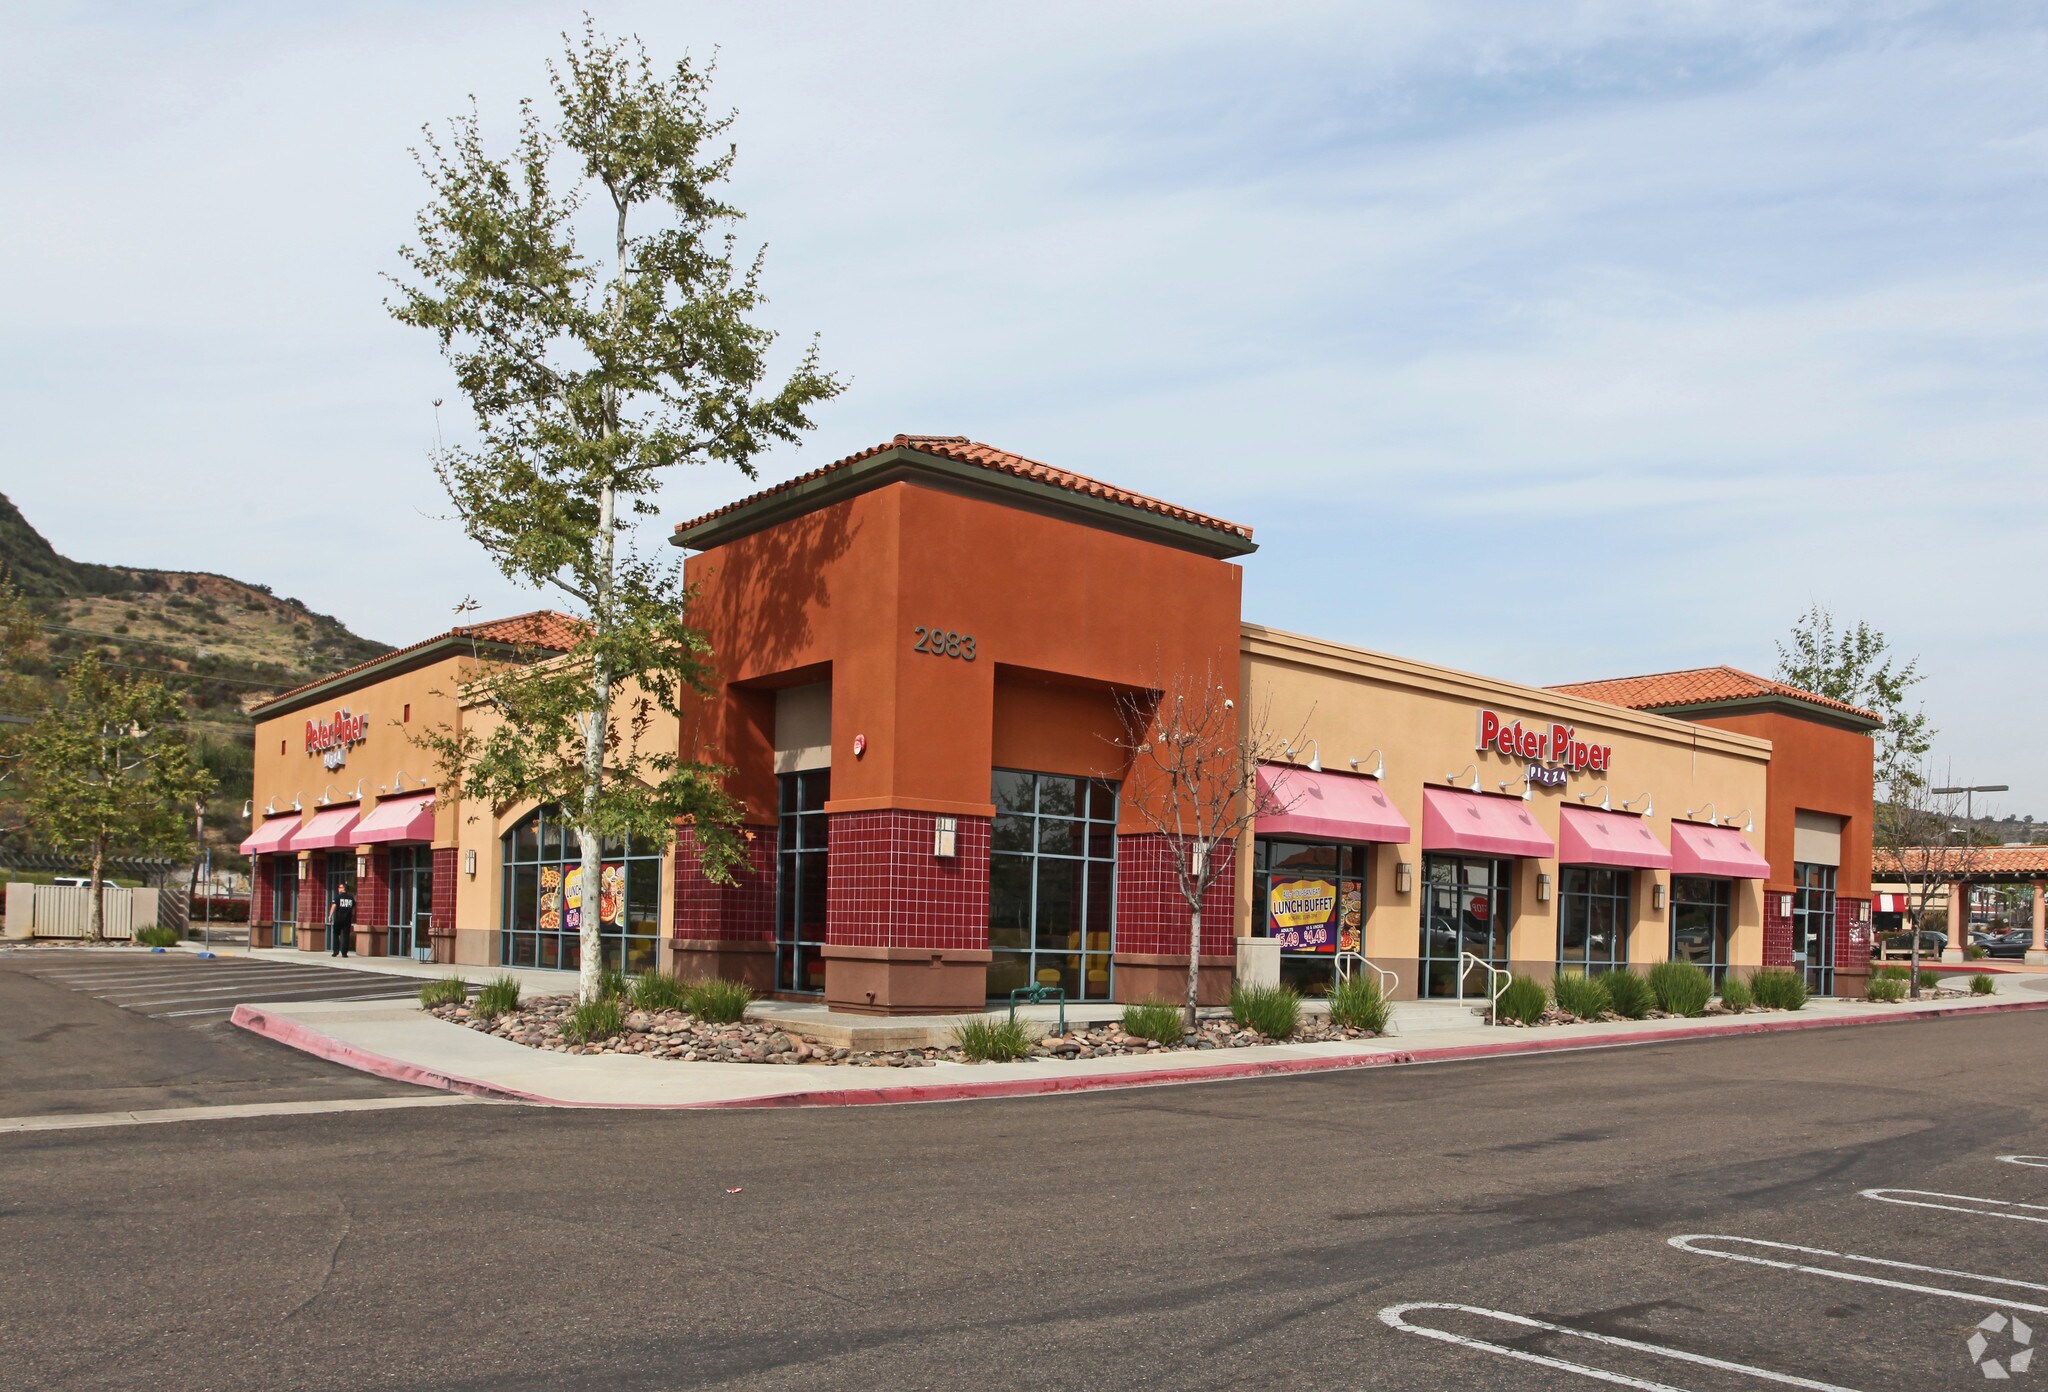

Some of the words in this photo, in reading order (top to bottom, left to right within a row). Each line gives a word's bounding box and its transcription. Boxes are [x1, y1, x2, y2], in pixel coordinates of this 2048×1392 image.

[914, 626, 977, 661] 2983
[306, 720, 333, 753] Peter
[334, 709, 364, 748] Piper
[1479, 709, 1548, 760] Peter
[1549, 723, 1612, 772] Piper
[1530, 766, 1567, 783] PIZZA
[1274, 900, 1302, 914] LUNCH
[1305, 898, 1332, 911] BUFFET
